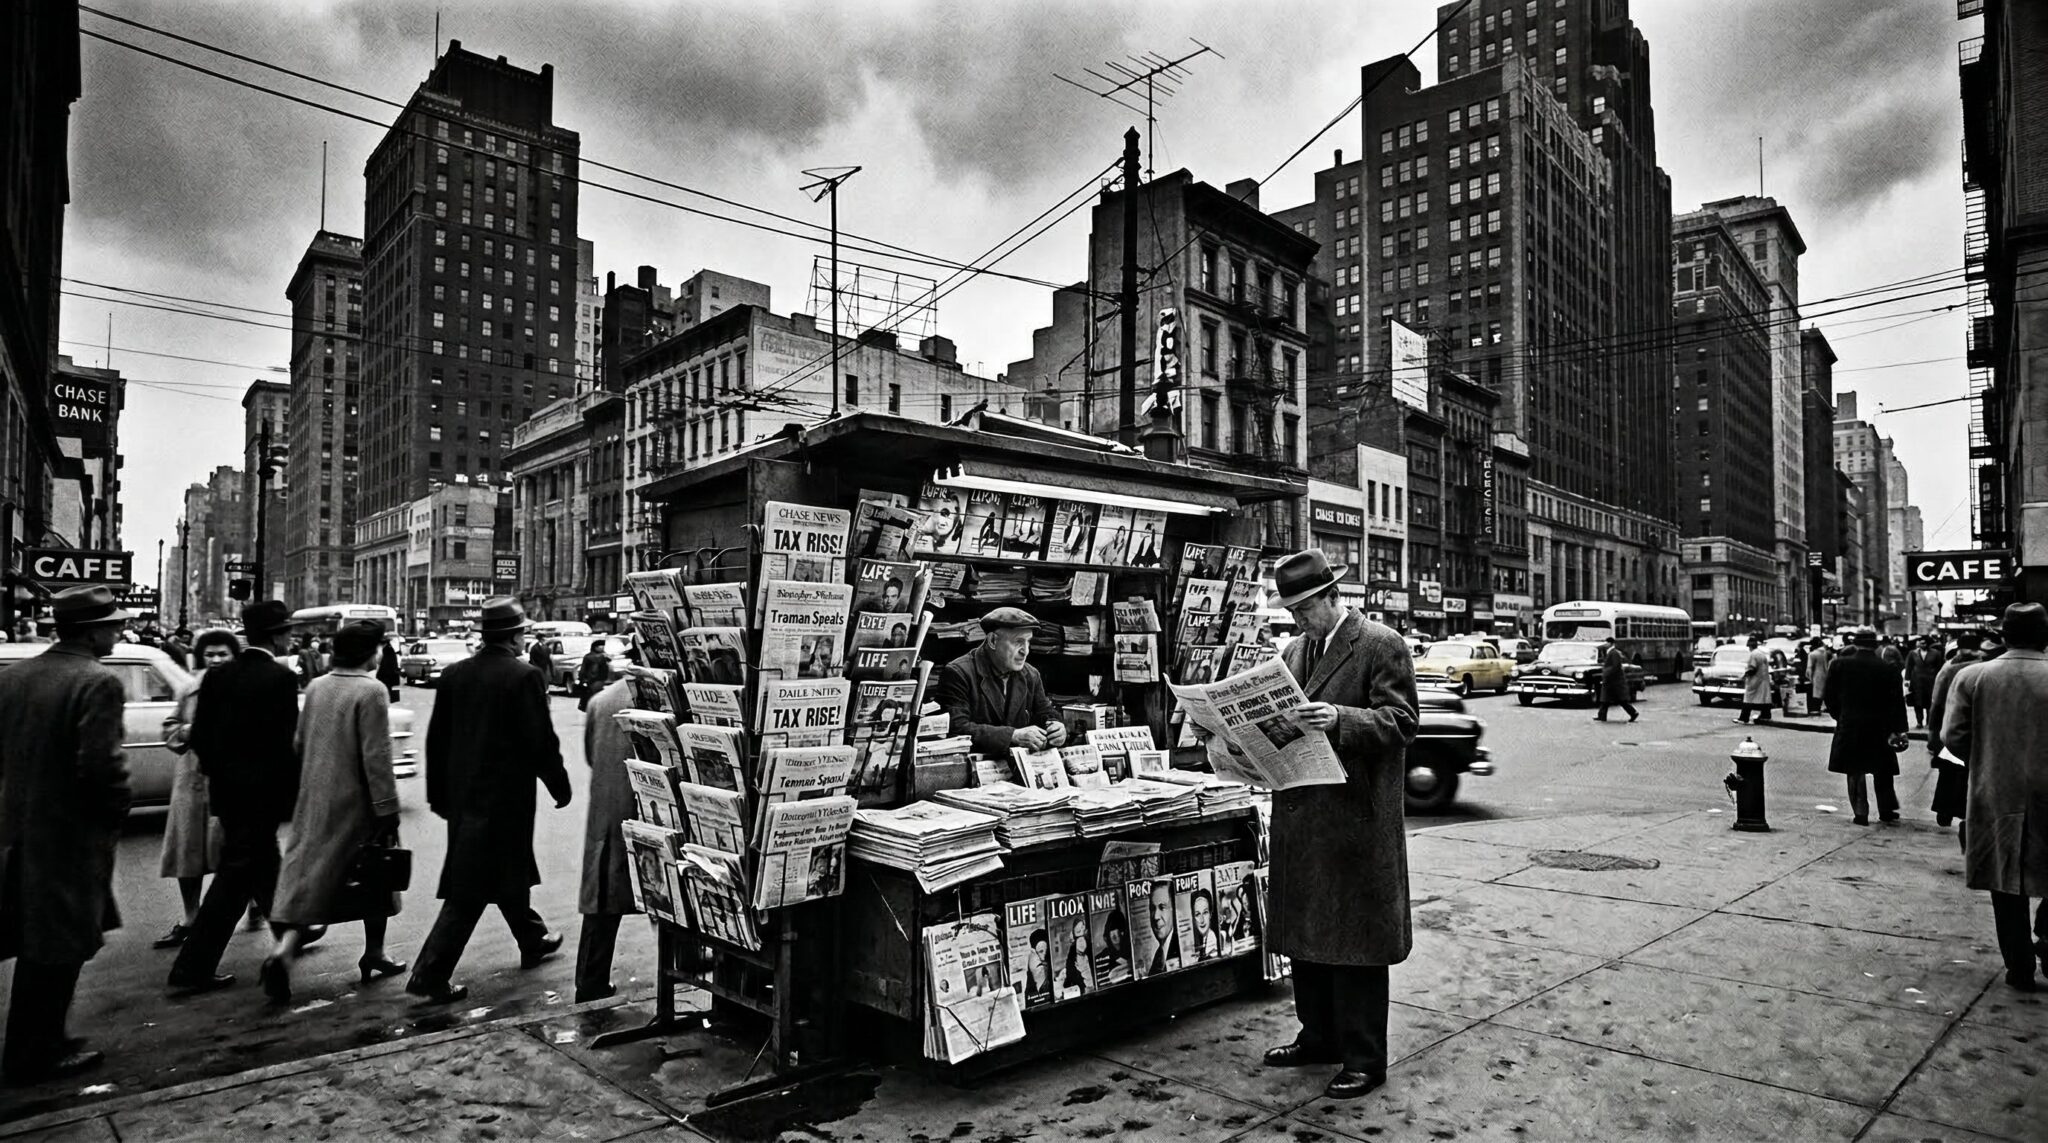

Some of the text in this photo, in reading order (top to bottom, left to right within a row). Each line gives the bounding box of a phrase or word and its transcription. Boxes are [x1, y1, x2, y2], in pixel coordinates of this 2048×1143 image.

[54, 384, 107, 404] CHASE
[58, 404, 103, 422] BANK
[778, 508, 842, 524] CHASE NEWS
[773, 529, 802, 552] TAX
[34, 556, 124, 580] CAFE
[1917, 559, 2002, 582] CAFE
[773, 705, 842, 729] TAX RISE!
[1009, 904, 1036, 926] LIFE
